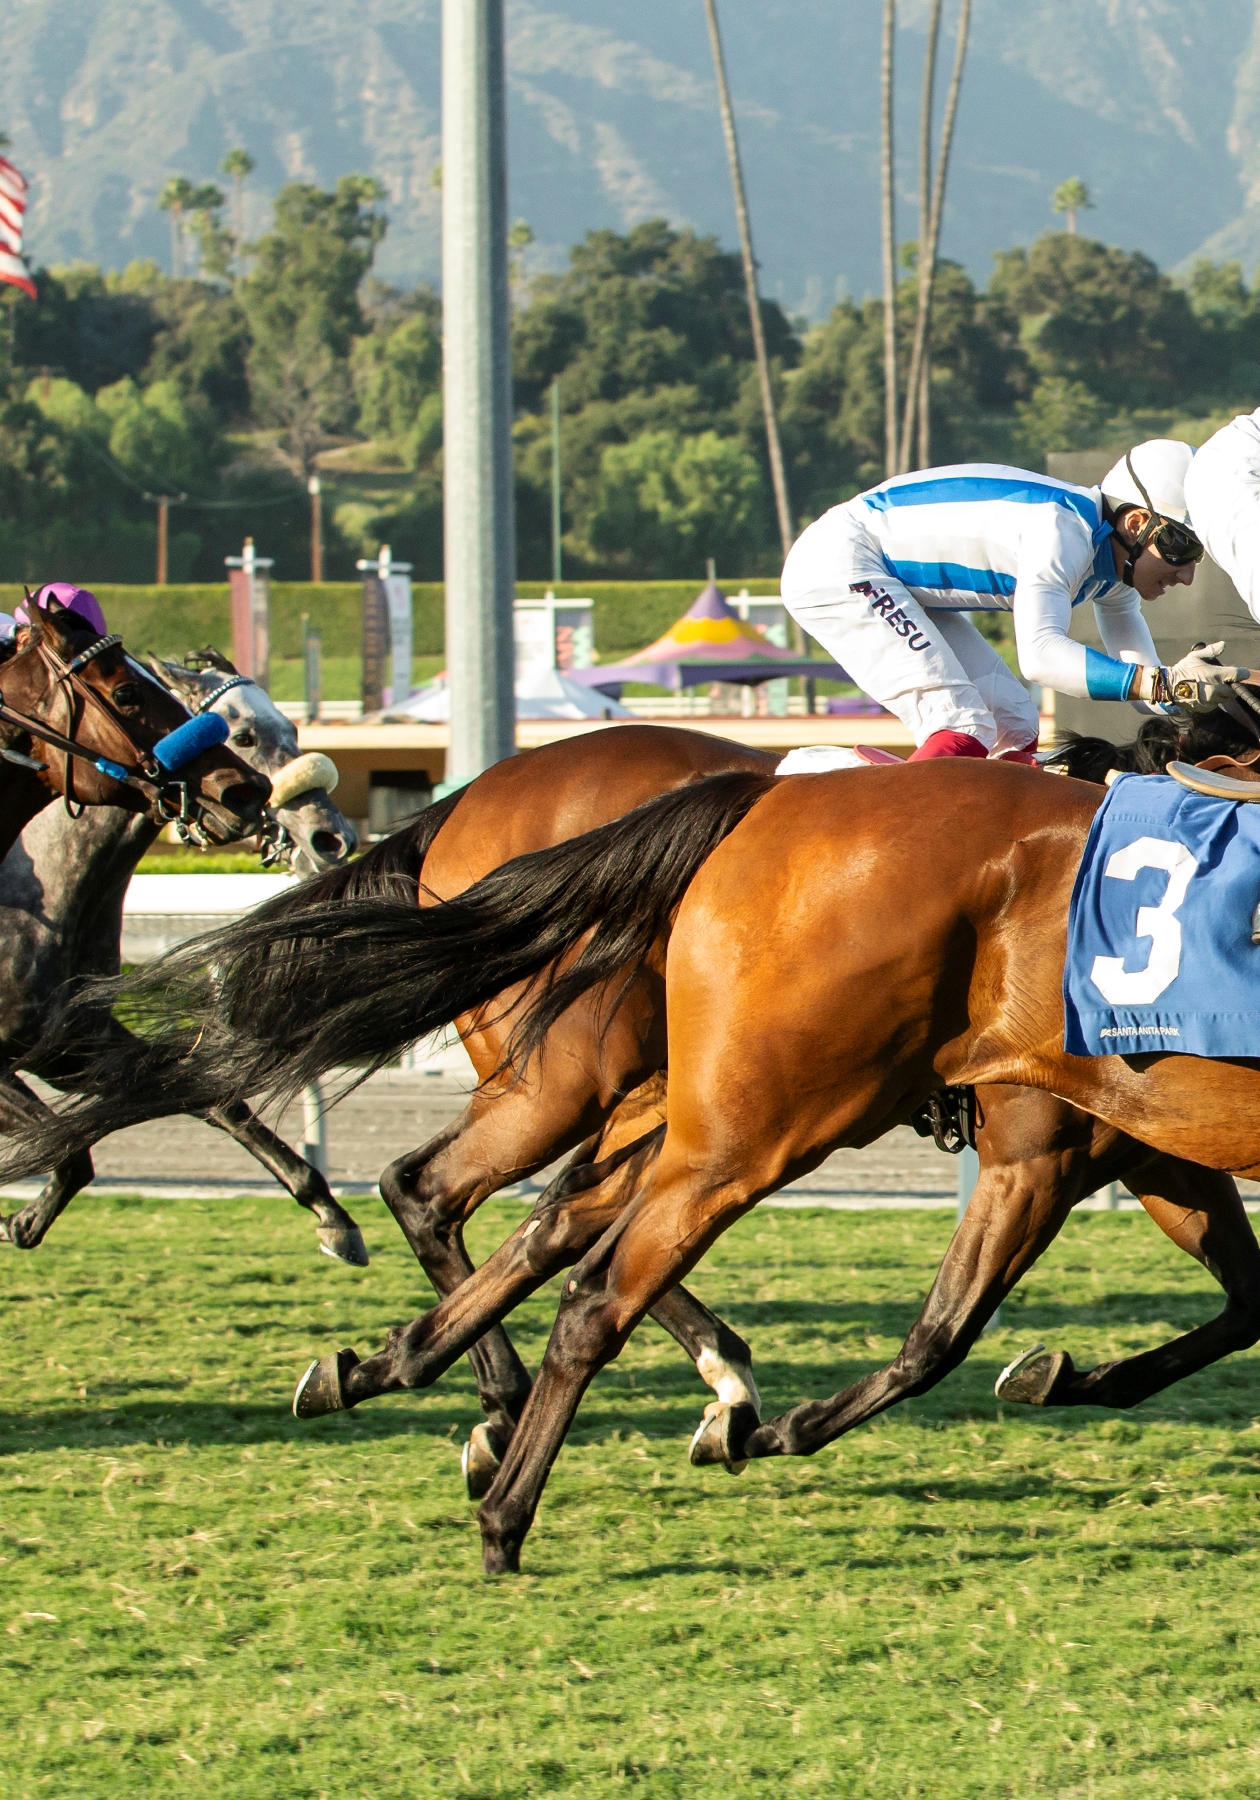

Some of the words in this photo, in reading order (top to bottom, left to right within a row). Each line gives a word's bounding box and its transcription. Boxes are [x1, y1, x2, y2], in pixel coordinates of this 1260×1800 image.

[1090, 836, 1198, 1005] 3
[1112, 1026, 1138, 1037] SANTA
[1138, 1026, 1160, 1035] ANITA
[1159, 1026, 1181, 1037] PARK
